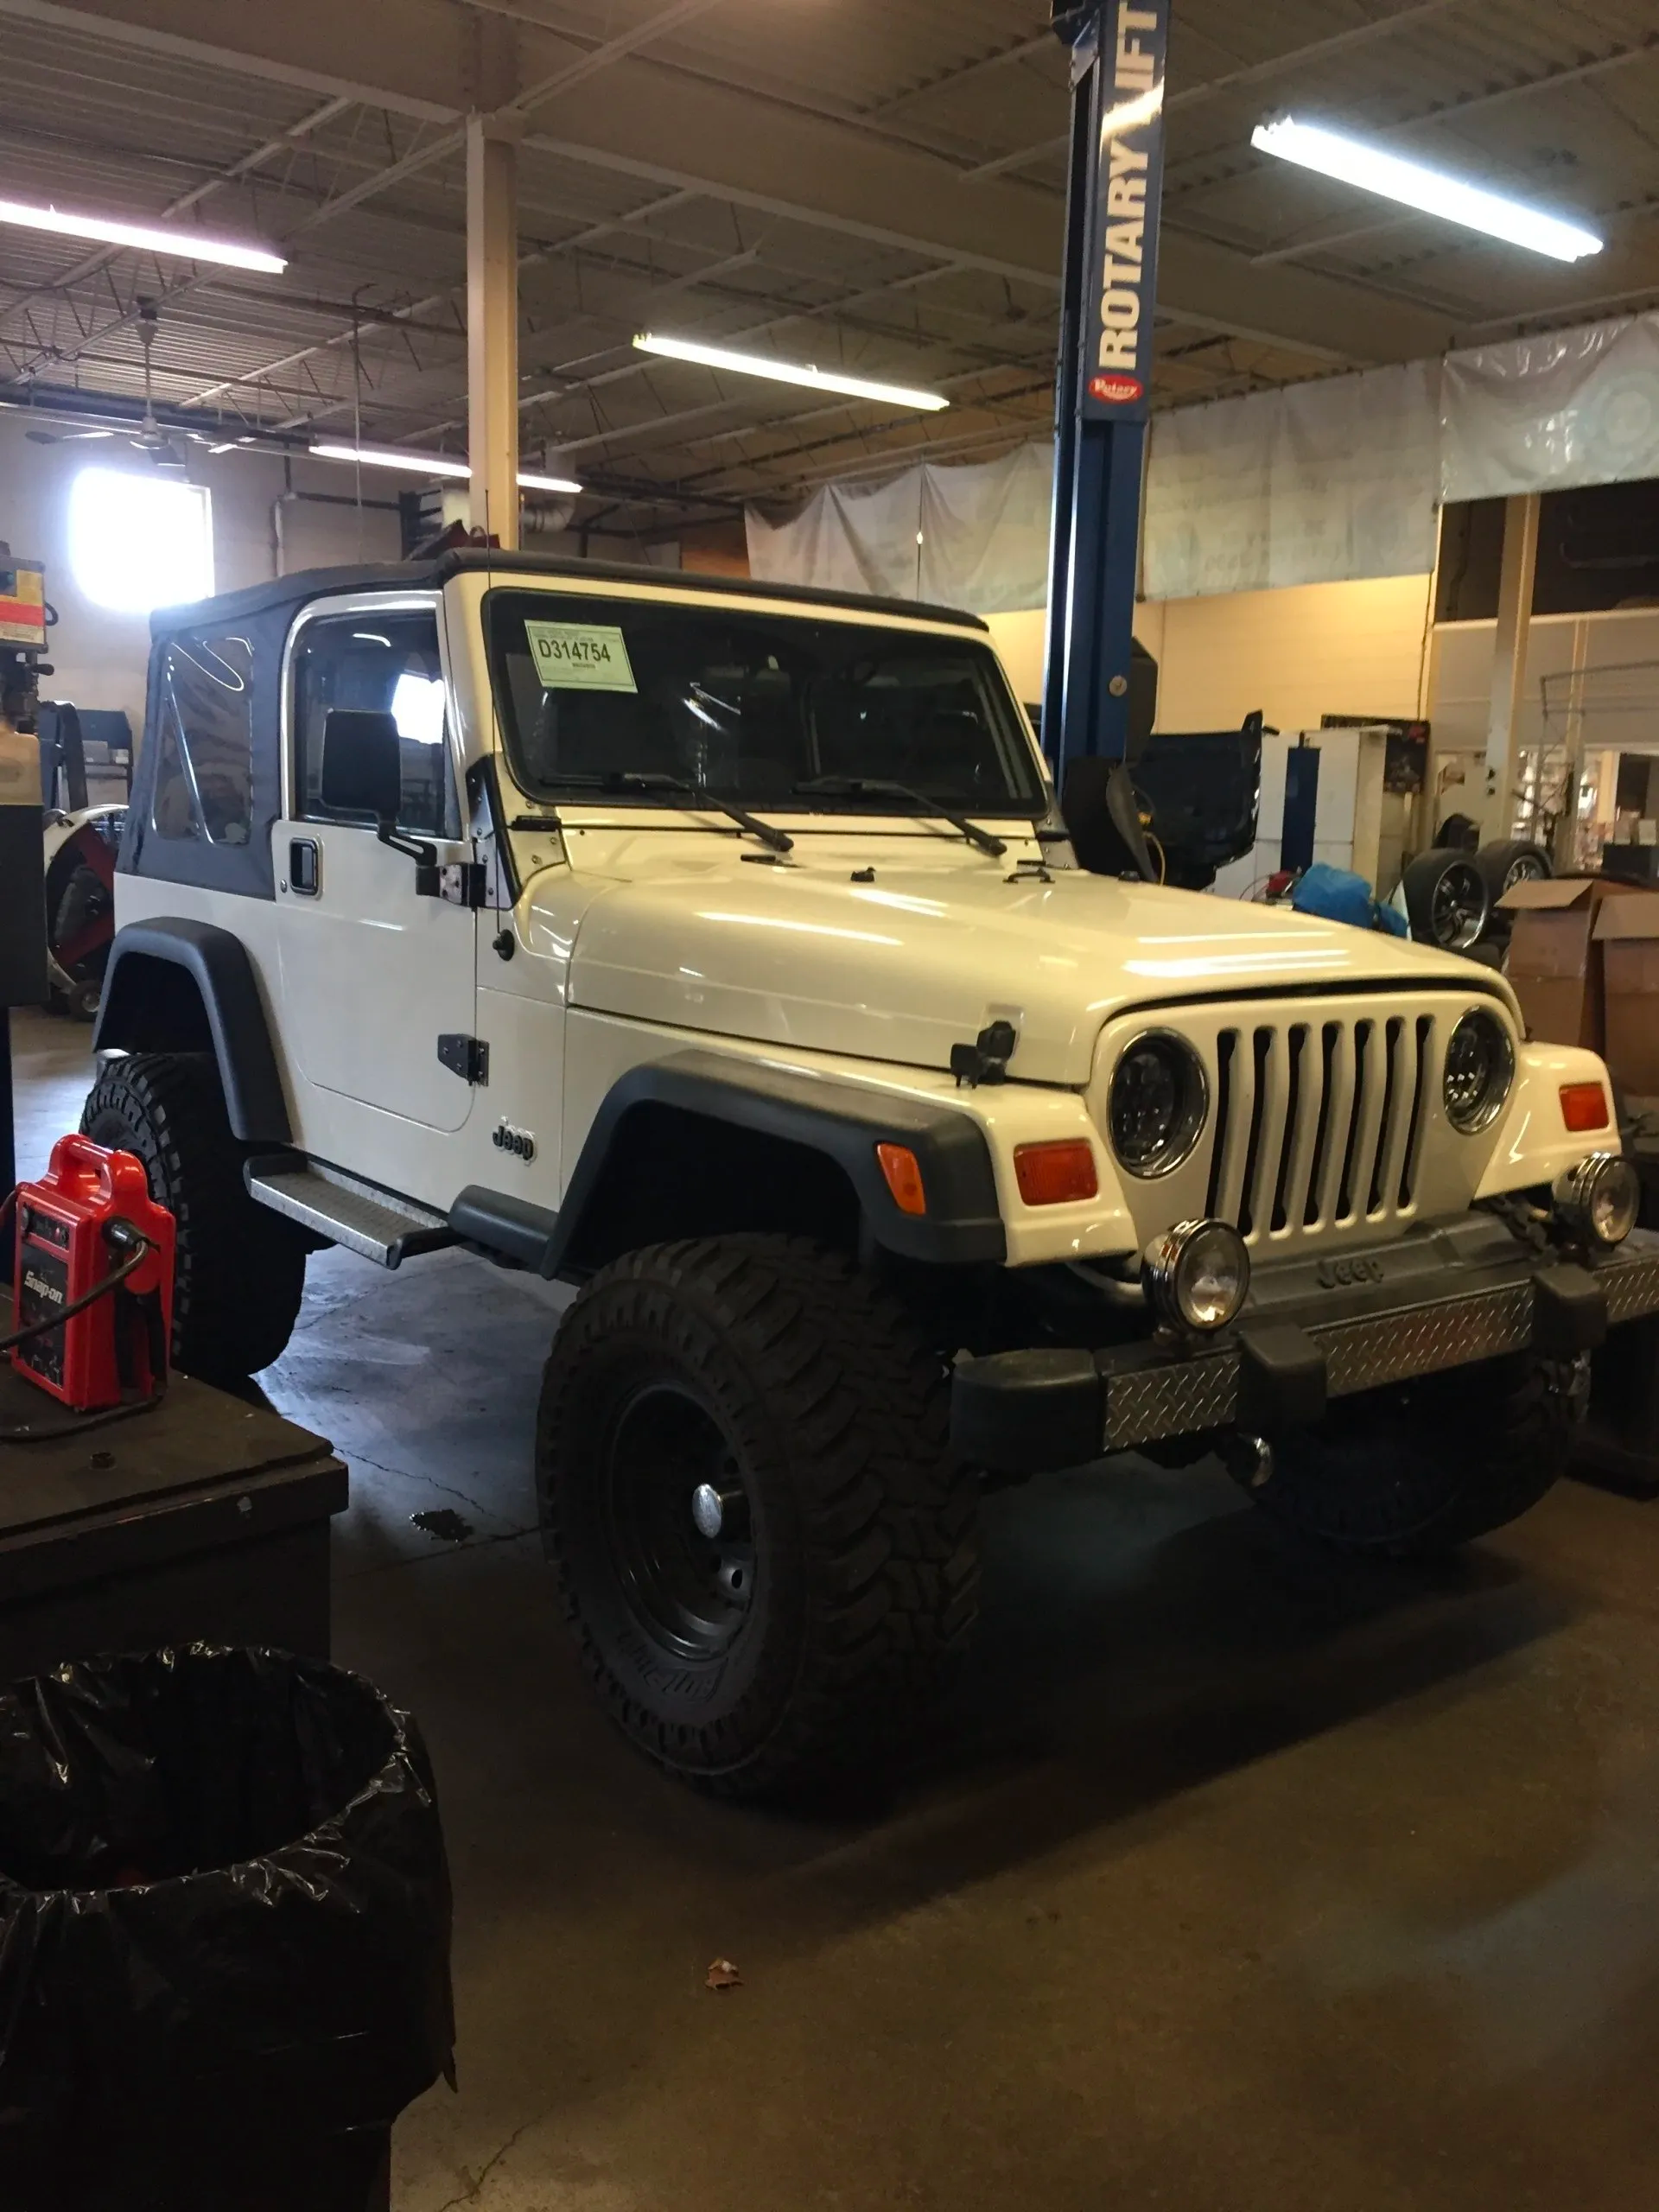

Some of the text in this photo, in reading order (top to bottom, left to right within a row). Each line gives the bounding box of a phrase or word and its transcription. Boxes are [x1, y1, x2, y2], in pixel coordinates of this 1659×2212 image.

[1098, 1, 1157, 370] ROTARY IFT
[537, 639, 611, 663] D314754
[24, 1269, 64, 1305] Snap-on
[1317, 1255, 1384, 1289] Jeep
